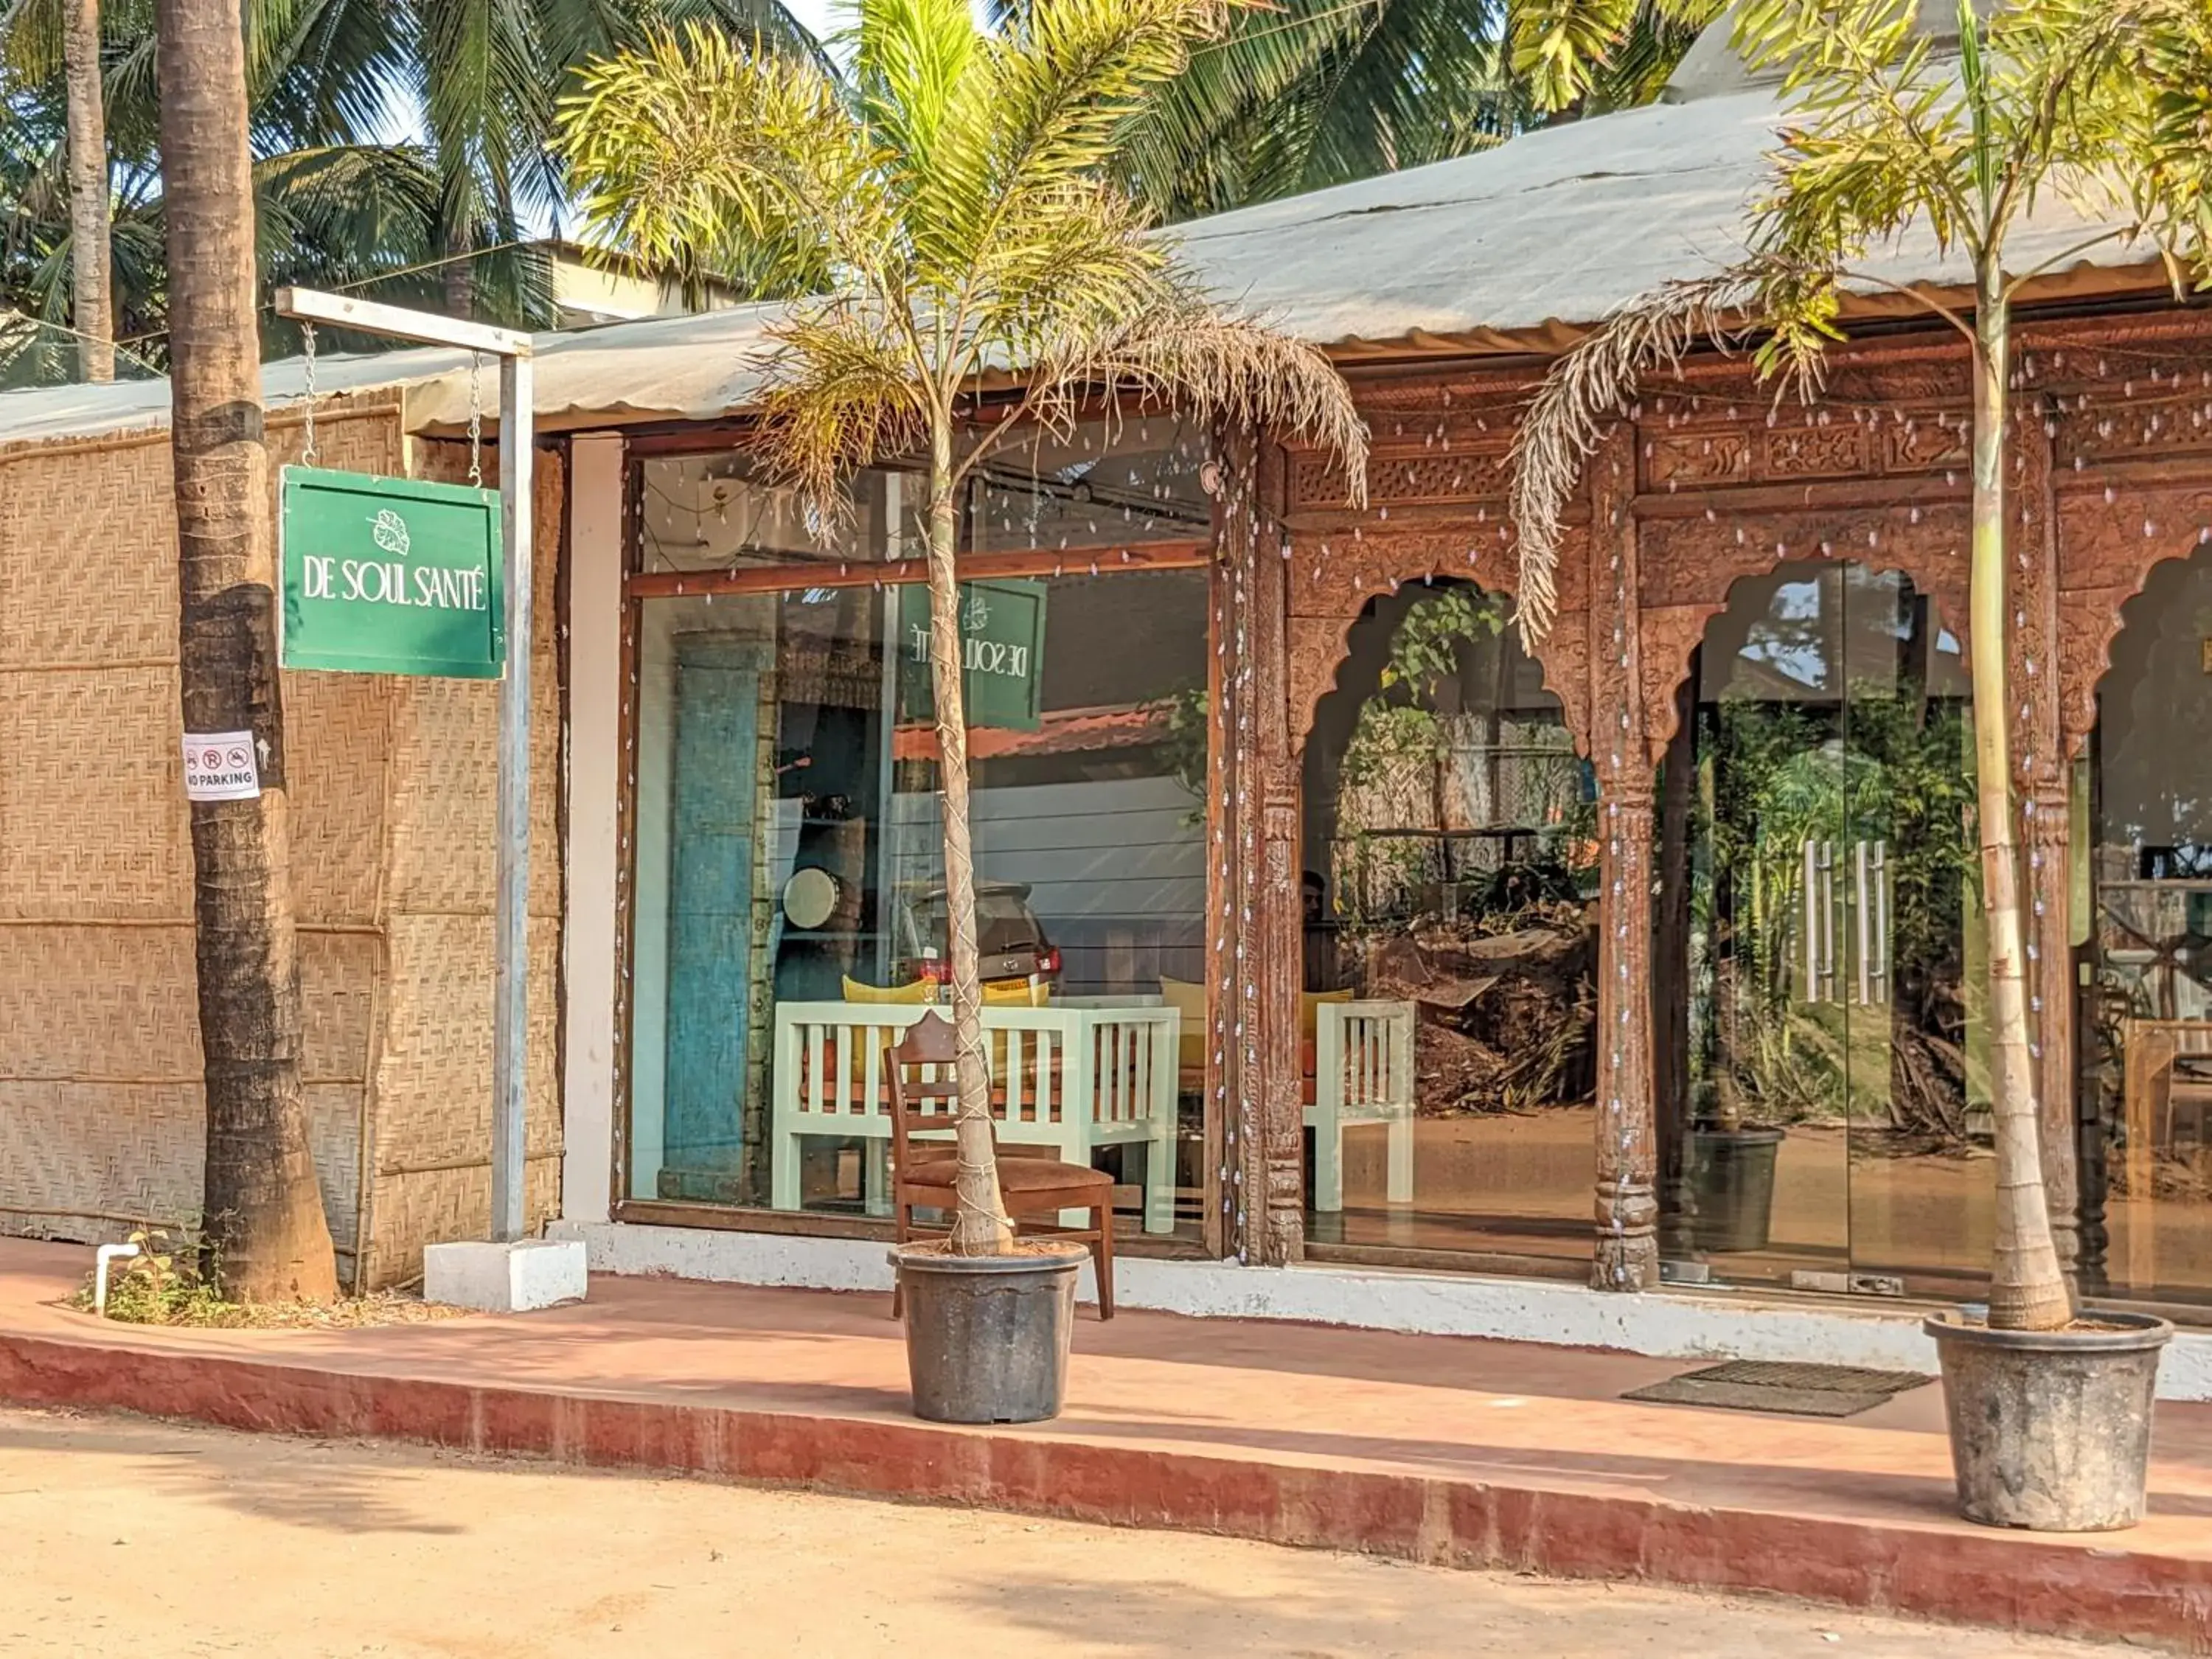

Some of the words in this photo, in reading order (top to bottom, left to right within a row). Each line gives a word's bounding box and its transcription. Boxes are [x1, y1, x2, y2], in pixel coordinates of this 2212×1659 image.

[303, 554, 335, 599] DE
[341, 560, 411, 605] SOUL
[414, 565, 486, 611] SANTÉ
[200, 772, 251, 786] PARKING
